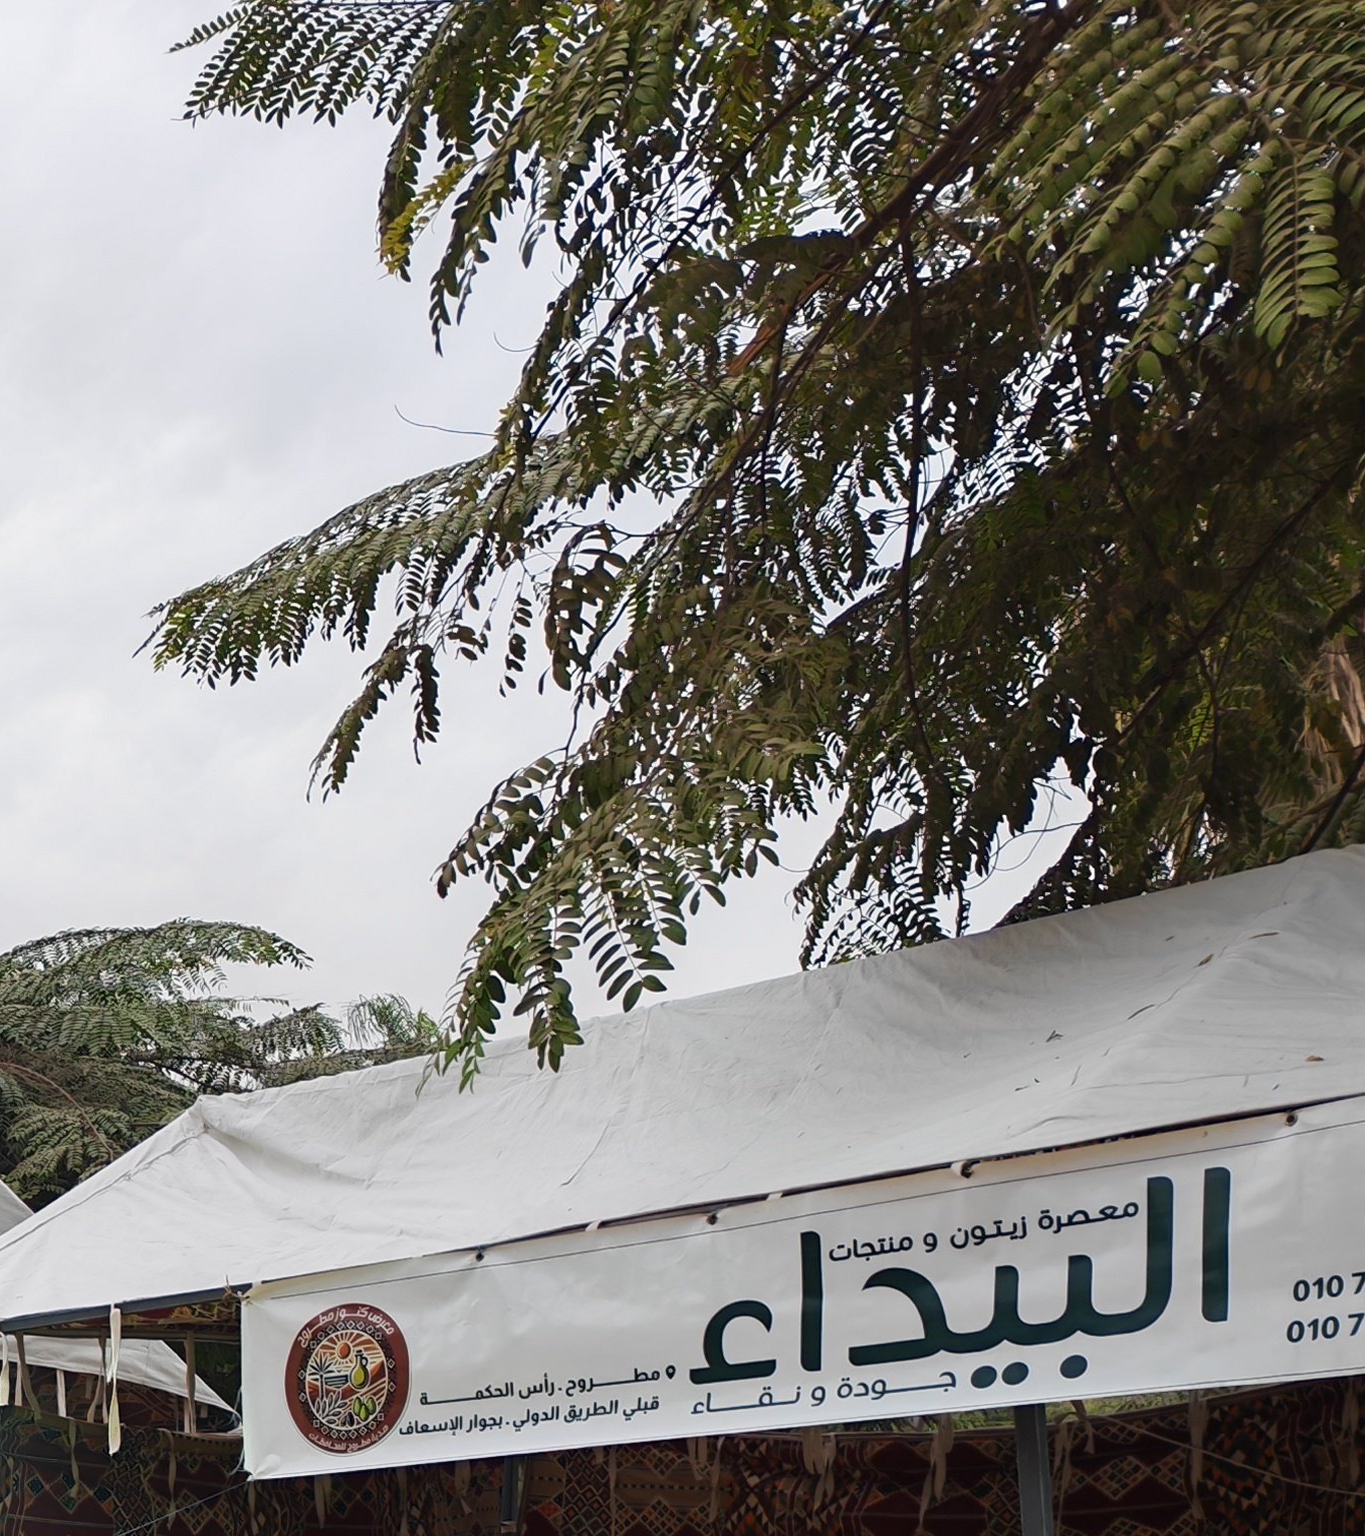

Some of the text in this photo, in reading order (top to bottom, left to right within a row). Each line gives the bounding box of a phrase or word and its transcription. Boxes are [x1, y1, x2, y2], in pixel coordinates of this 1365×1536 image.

[829, 1201, 1139, 1261] معصرة زيتون و منتجات
[689, 1166, 1231, 1390] البيداء
[1293, 1274, 1344, 1302] 010
[1286, 1315, 1340, 1343] 010
[419, 1367, 661, 1406] مطروح رأس الحكمة
[837, 1371, 957, 1400] جودة
[512, 1405, 561, 1433] الدولي
[563, 1399, 619, 1427] الطريق
[622, 1396, 660, 1420] قبلي
[467, 1411, 503, 1435] بجوار
